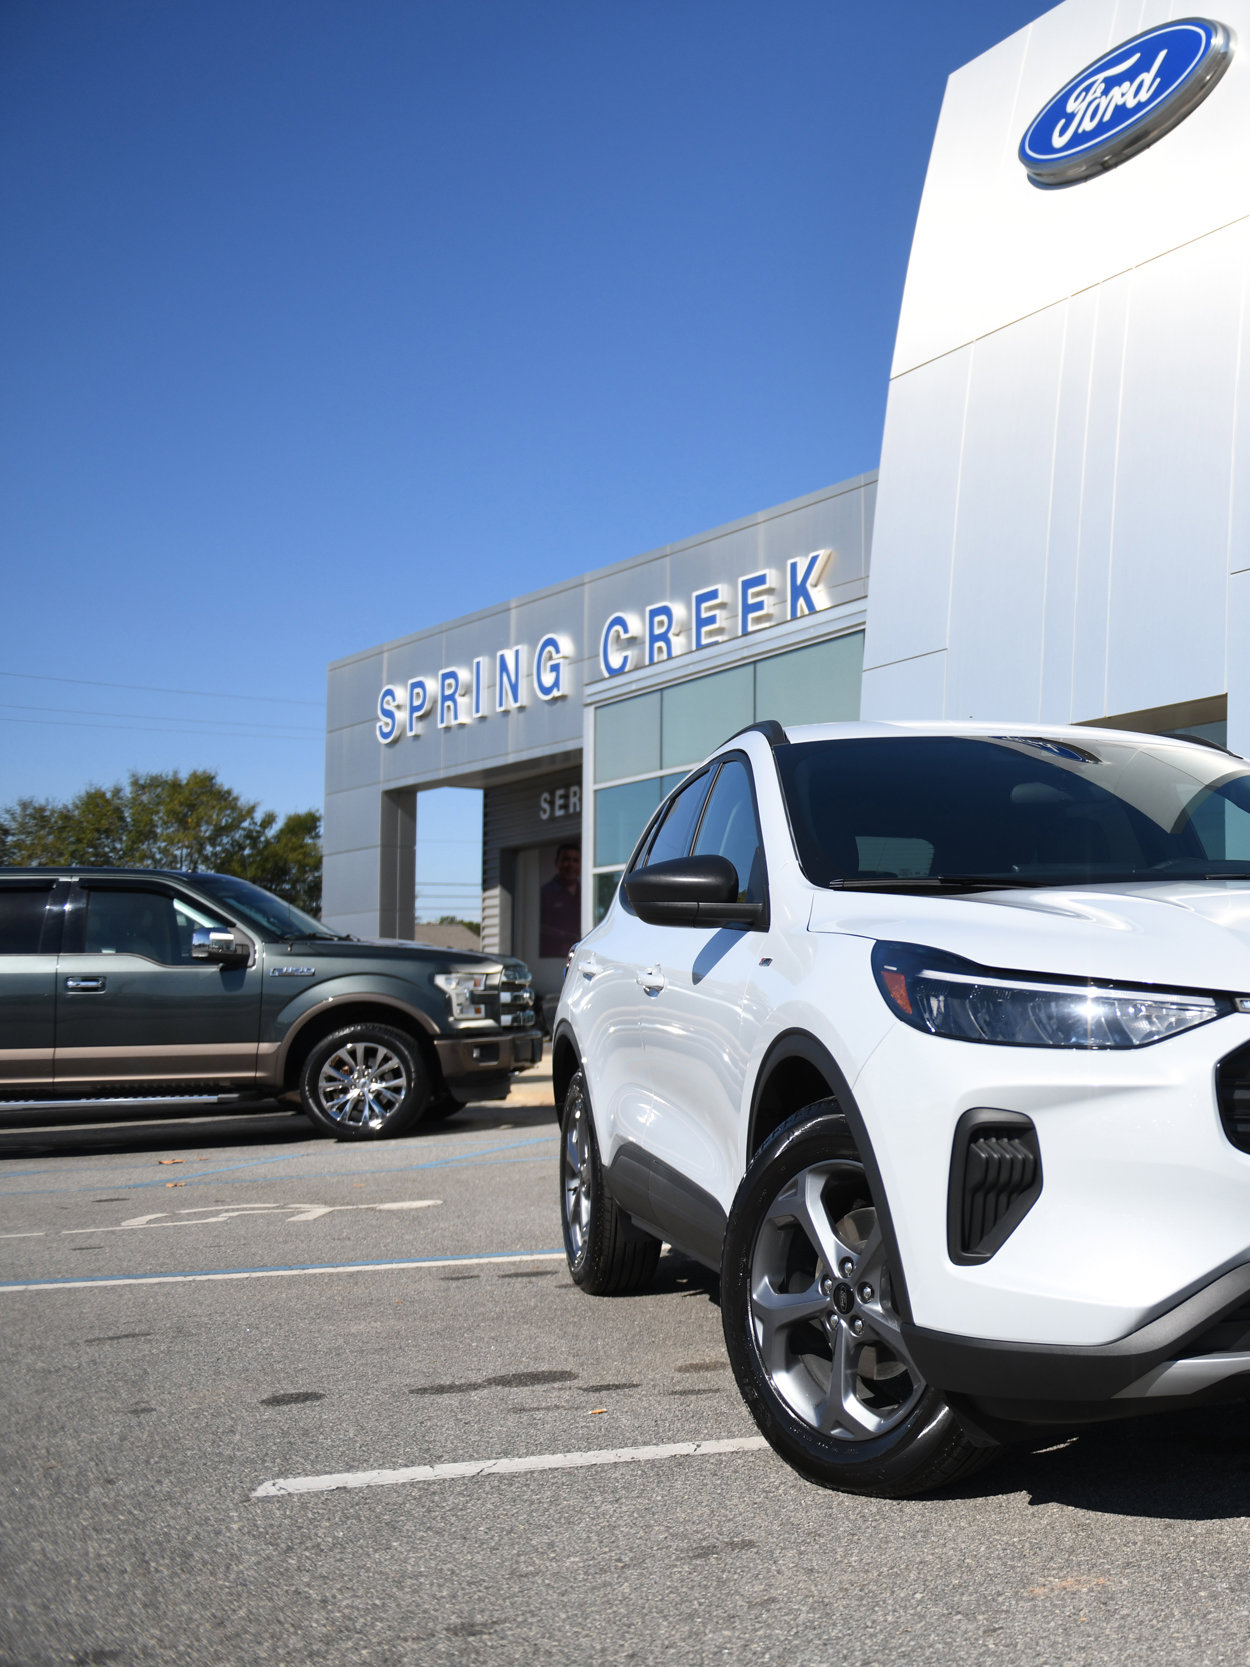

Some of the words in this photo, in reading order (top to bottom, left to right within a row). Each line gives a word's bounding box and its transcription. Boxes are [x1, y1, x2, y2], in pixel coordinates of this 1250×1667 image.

[1051, 48, 1168, 149] Ford
[376, 632, 574, 745] SPRING
[600, 548, 833, 678] CREEK
